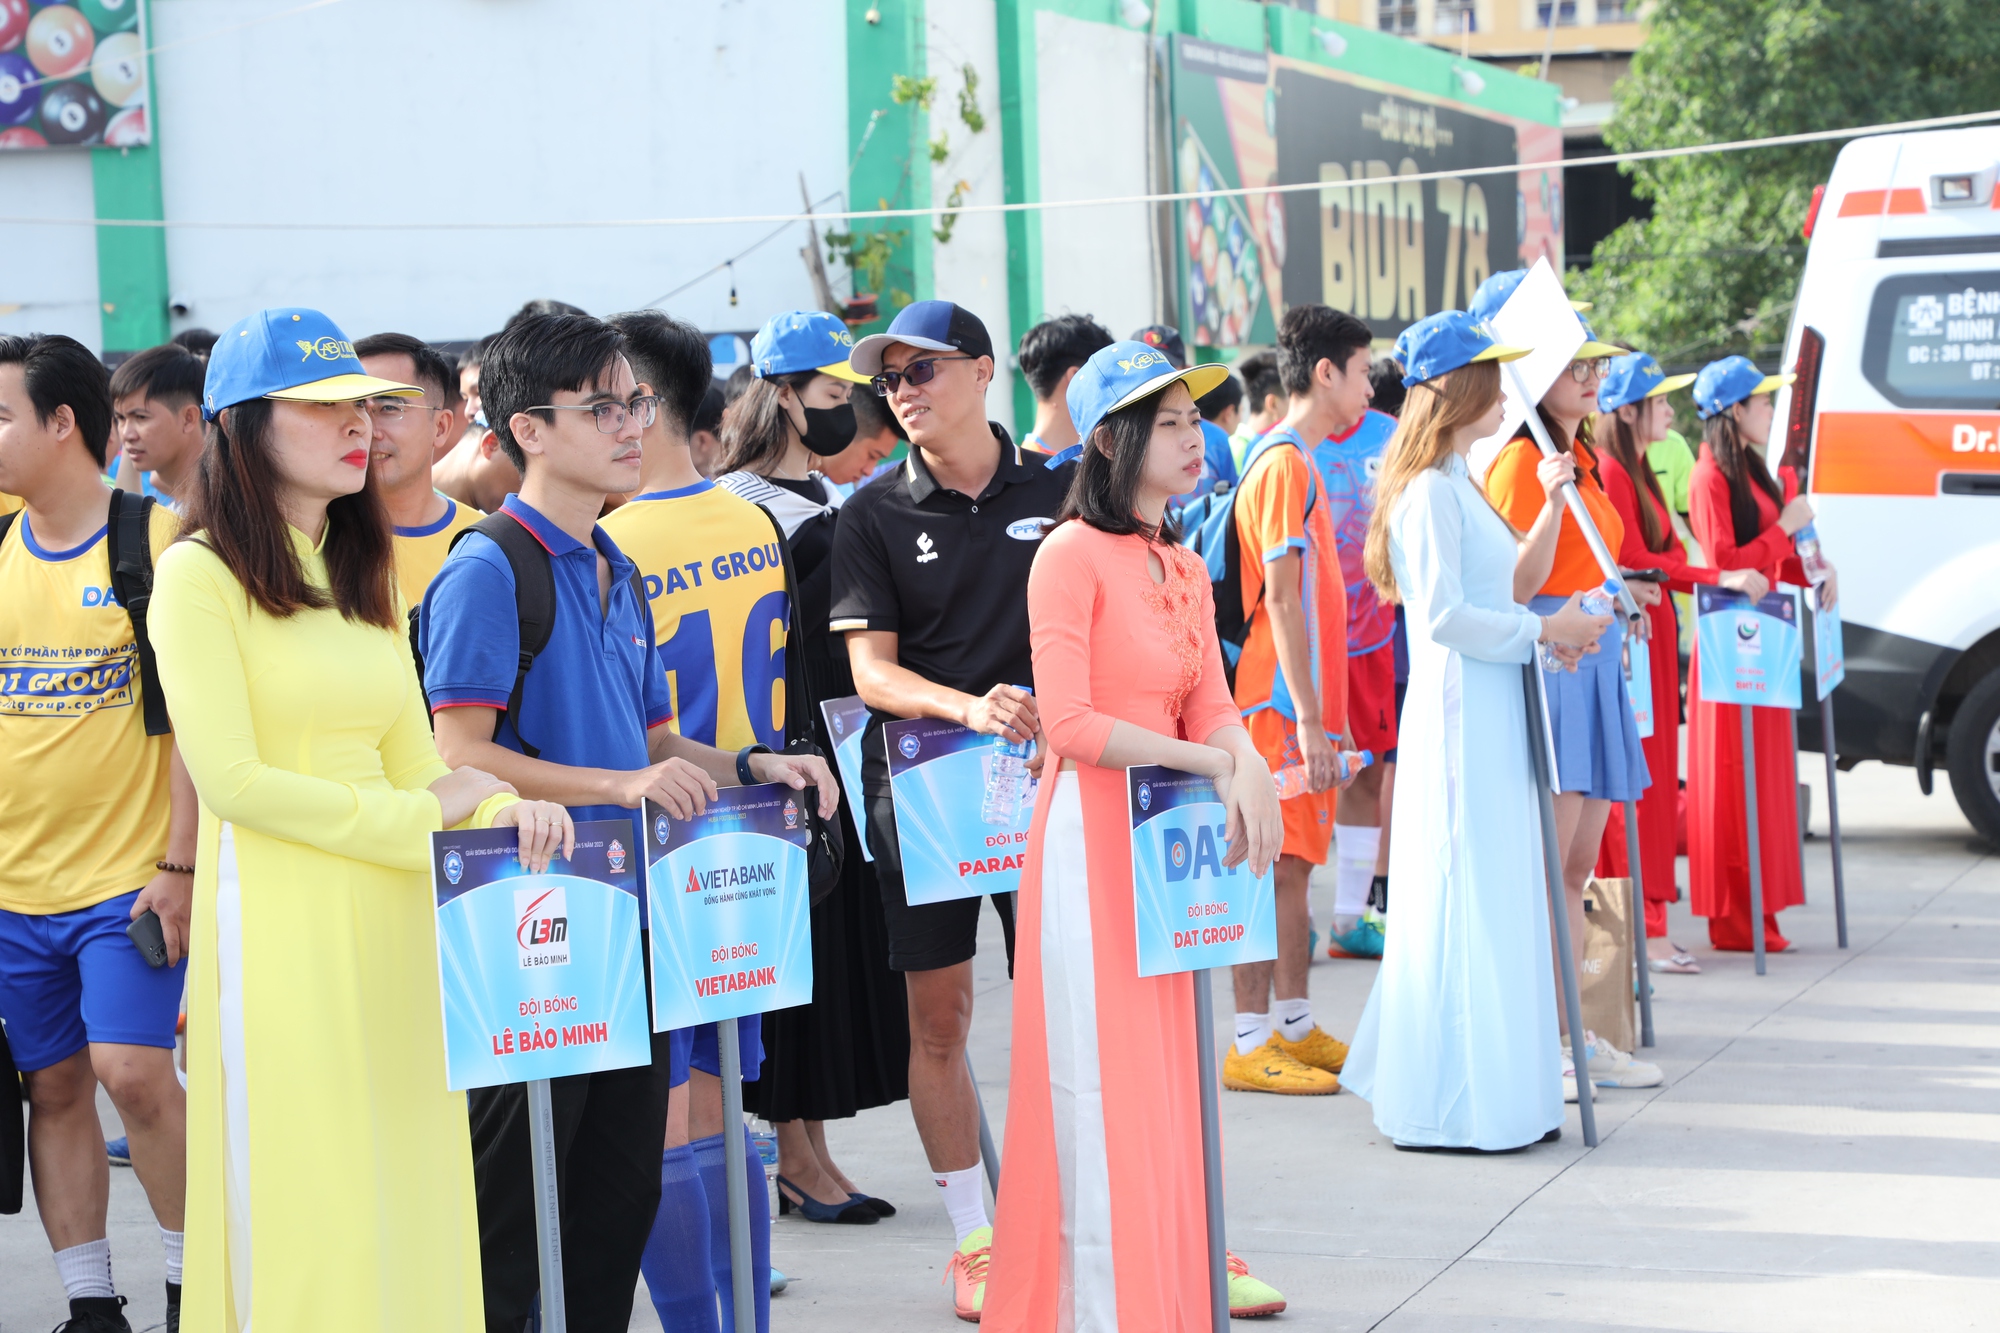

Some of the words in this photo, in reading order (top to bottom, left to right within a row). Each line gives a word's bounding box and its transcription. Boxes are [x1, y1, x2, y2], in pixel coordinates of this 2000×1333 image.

[1319, 157, 1427, 322] BIDA
[1436, 176, 1490, 312] 78
[1947, 319, 1994, 341] MINH
[1952, 424, 2000, 453] Dr.
[643, 561, 702, 600] DAT
[24, 645, 59, 658] PHẦN
[62, 646, 82, 660] TẬP
[85, 645, 120, 657] ĐOÀN
[28, 665, 127, 692] GROUP
[655, 590, 790, 750] 16
[985, 832, 1011, 848] ĐỘI
[699, 862, 776, 890] VIETABANK
[1188, 902, 1203, 920] ĐỘI
[1205, 900, 1229, 916] BÓNG
[1174, 929, 1199, 949] DAT
[1202, 924, 1245, 945] GROUP
[522, 955, 532, 967] LÊ
[534, 953, 549, 966] BẢO
[550, 954, 568, 964] MINH
[711, 945, 729, 965] ĐỘI
[731, 942, 758, 960] BÓNG
[695, 966, 777, 998] VIETABANK
[519, 997, 541, 1019] ĐỘI
[544, 995, 578, 1014] BÓNG
[492, 1027, 515, 1056] LÊ
[518, 1021, 558, 1052] BẢO
[562, 1022, 608, 1047] MINH
